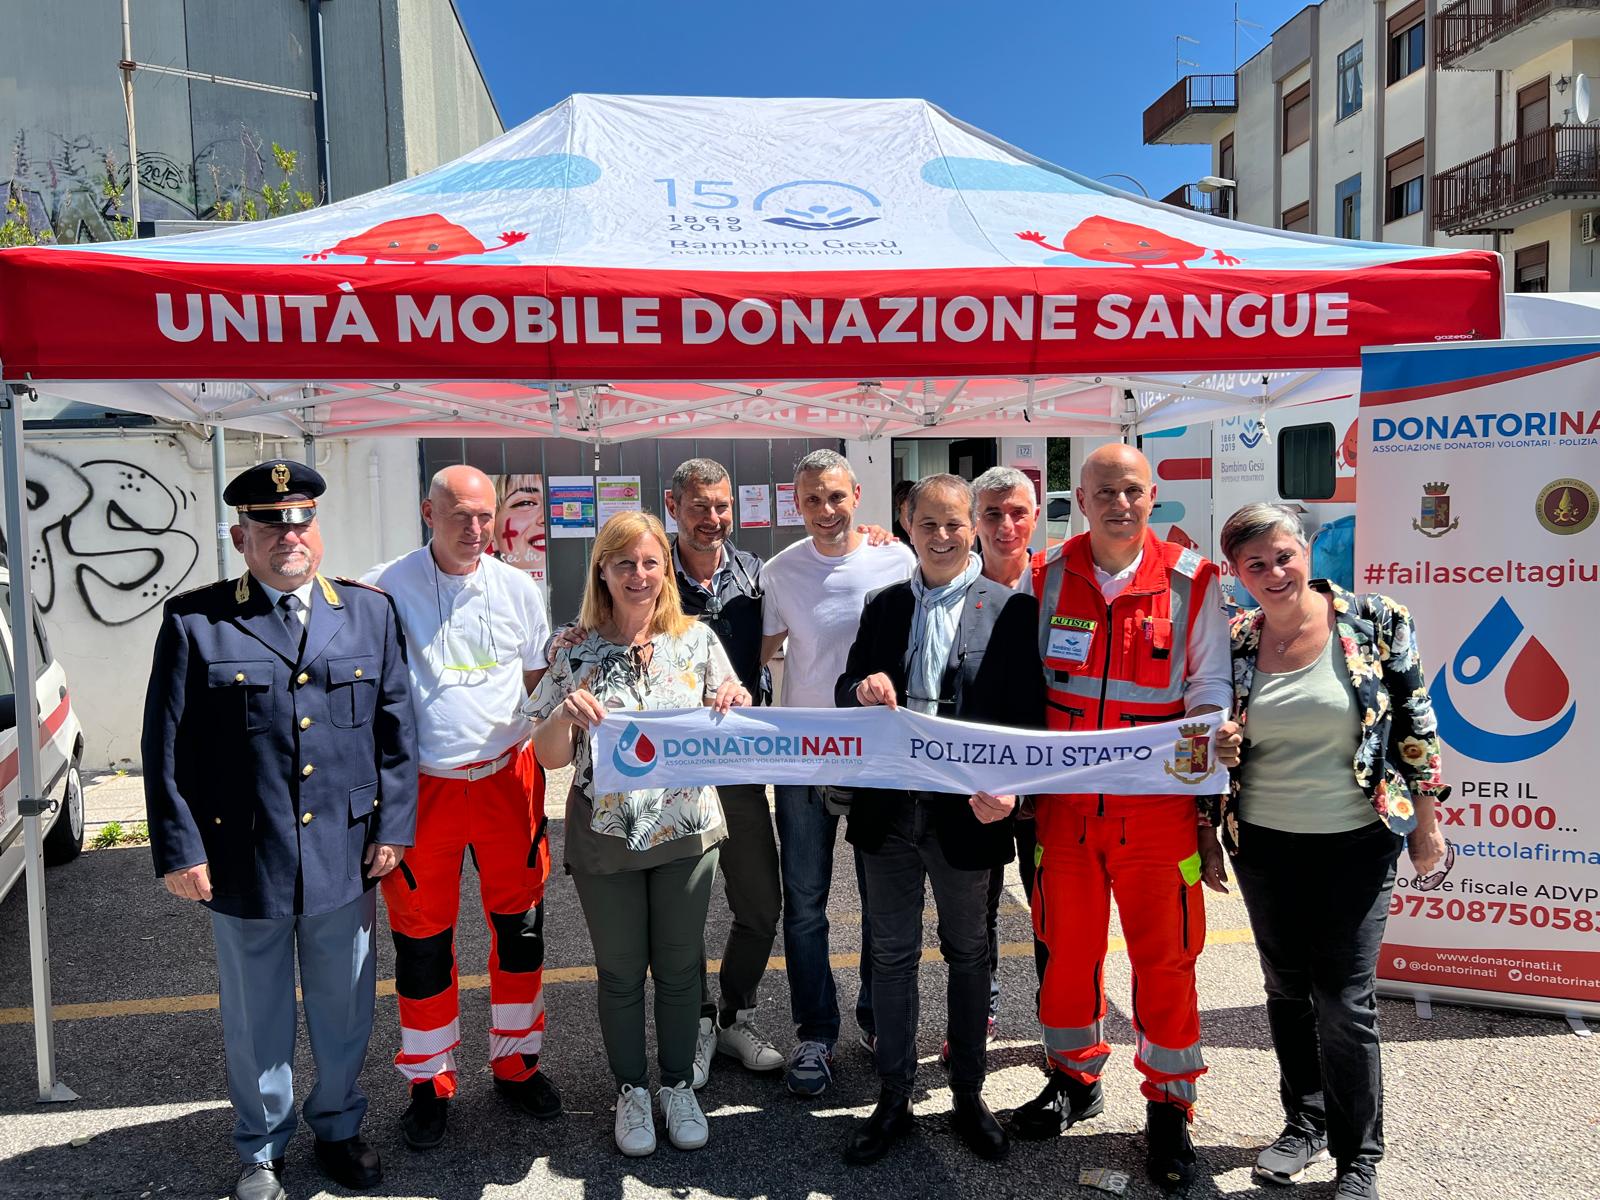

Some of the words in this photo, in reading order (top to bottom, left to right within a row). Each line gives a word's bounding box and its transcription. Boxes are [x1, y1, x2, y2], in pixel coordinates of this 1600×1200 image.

[668, 214, 741, 224] 1869
[669, 224, 742, 232] 2019
[670, 239, 809, 249] Bambino
[823, 239, 898, 249] Gesù
[155, 281, 380, 343] UNITÀ
[395, 294, 661, 344] MOBILE
[682, 293, 1077, 346] DONAZIONE
[1093, 292, 1349, 341] SANGUE
[1020, 447, 1031, 456] 172
[1372, 443, 1441, 453] ASSOCIAZIONE
[1444, 441, 1495, 450] DONATORI
[1498, 439, 1551, 448] VOLONTARI
[1559, 437, 1598, 446] POLIZIA
[1221, 461, 1248, 473] Bambino
[1054, 617, 1091, 628] AUTISTA
[663, 736, 862, 758] DONATORINATI
[910, 738, 1017, 766] POLIZIA
[1026, 746, 1053, 766] DI
[1062, 745, 1153, 767] STATO
[665, 758, 717, 766] ASSOCIAZIONE
[1462, 781, 1509, 799] PER
[1518, 782, 1538, 799] IL
[1461, 878, 1528, 897] fiscale
[1534, 884, 1599, 903] ADVP
[1389, 893, 1600, 933] 9730875058
[1409, 961, 1497, 978] @donatorinati
[1436, 952, 1562, 972] www.donatorinati.it
